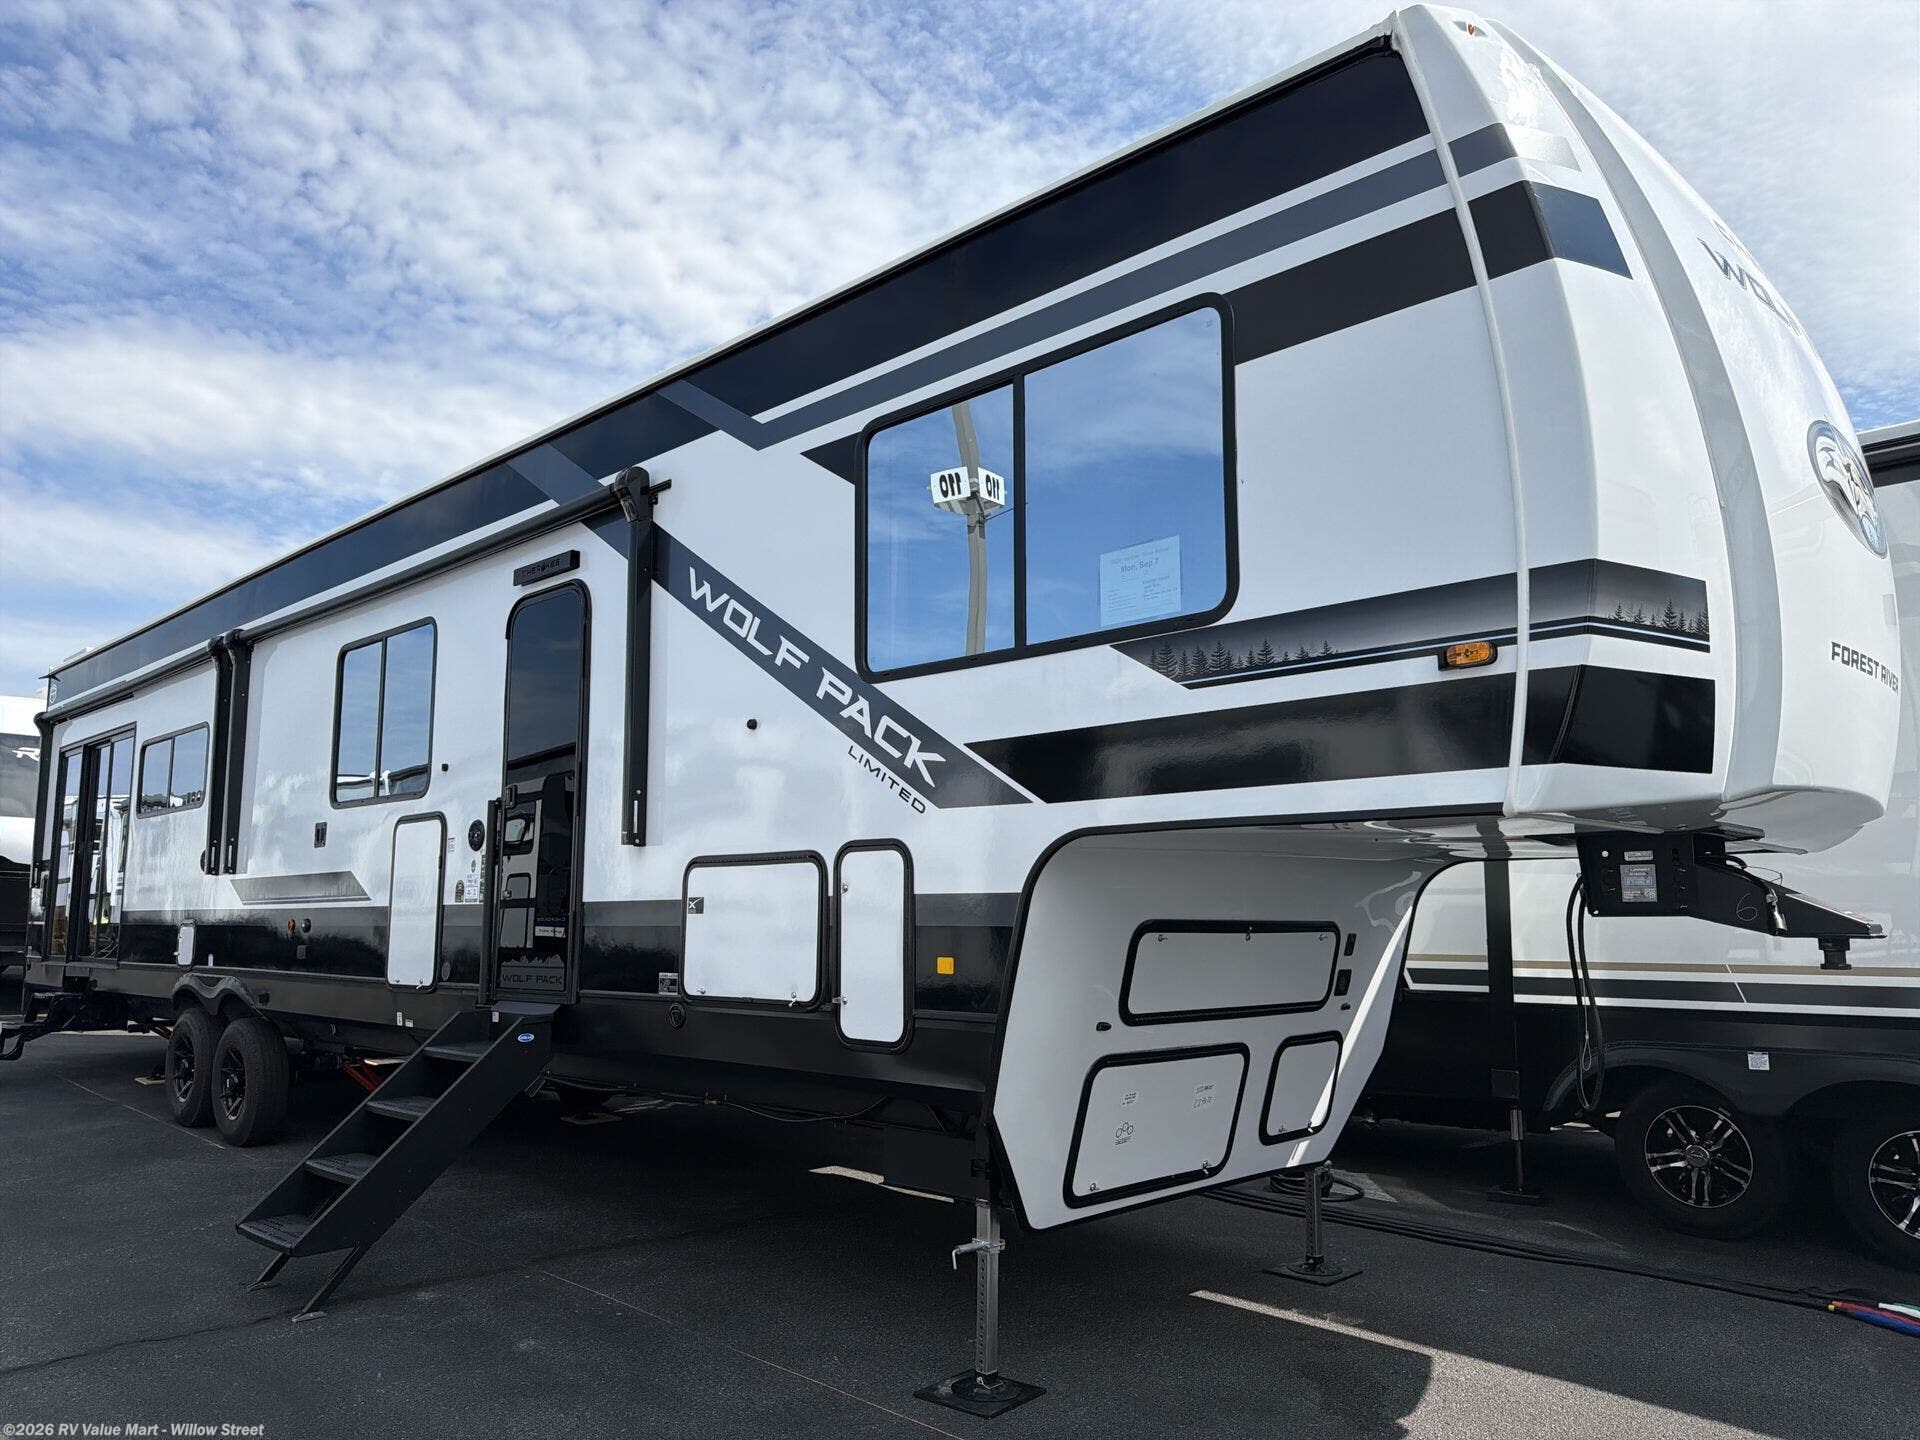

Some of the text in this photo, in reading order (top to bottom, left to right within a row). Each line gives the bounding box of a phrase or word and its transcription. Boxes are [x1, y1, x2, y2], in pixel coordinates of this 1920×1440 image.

[1139, 560, 1154, 569] Sep
[690, 566, 947, 788] WOLF PACK
[1830, 641, 1880, 679] FOREST
[848, 745, 926, 814] LIMITED
[1736, 892, 1758, 922] 6
[502, 974, 563, 984] WOLF PACK
